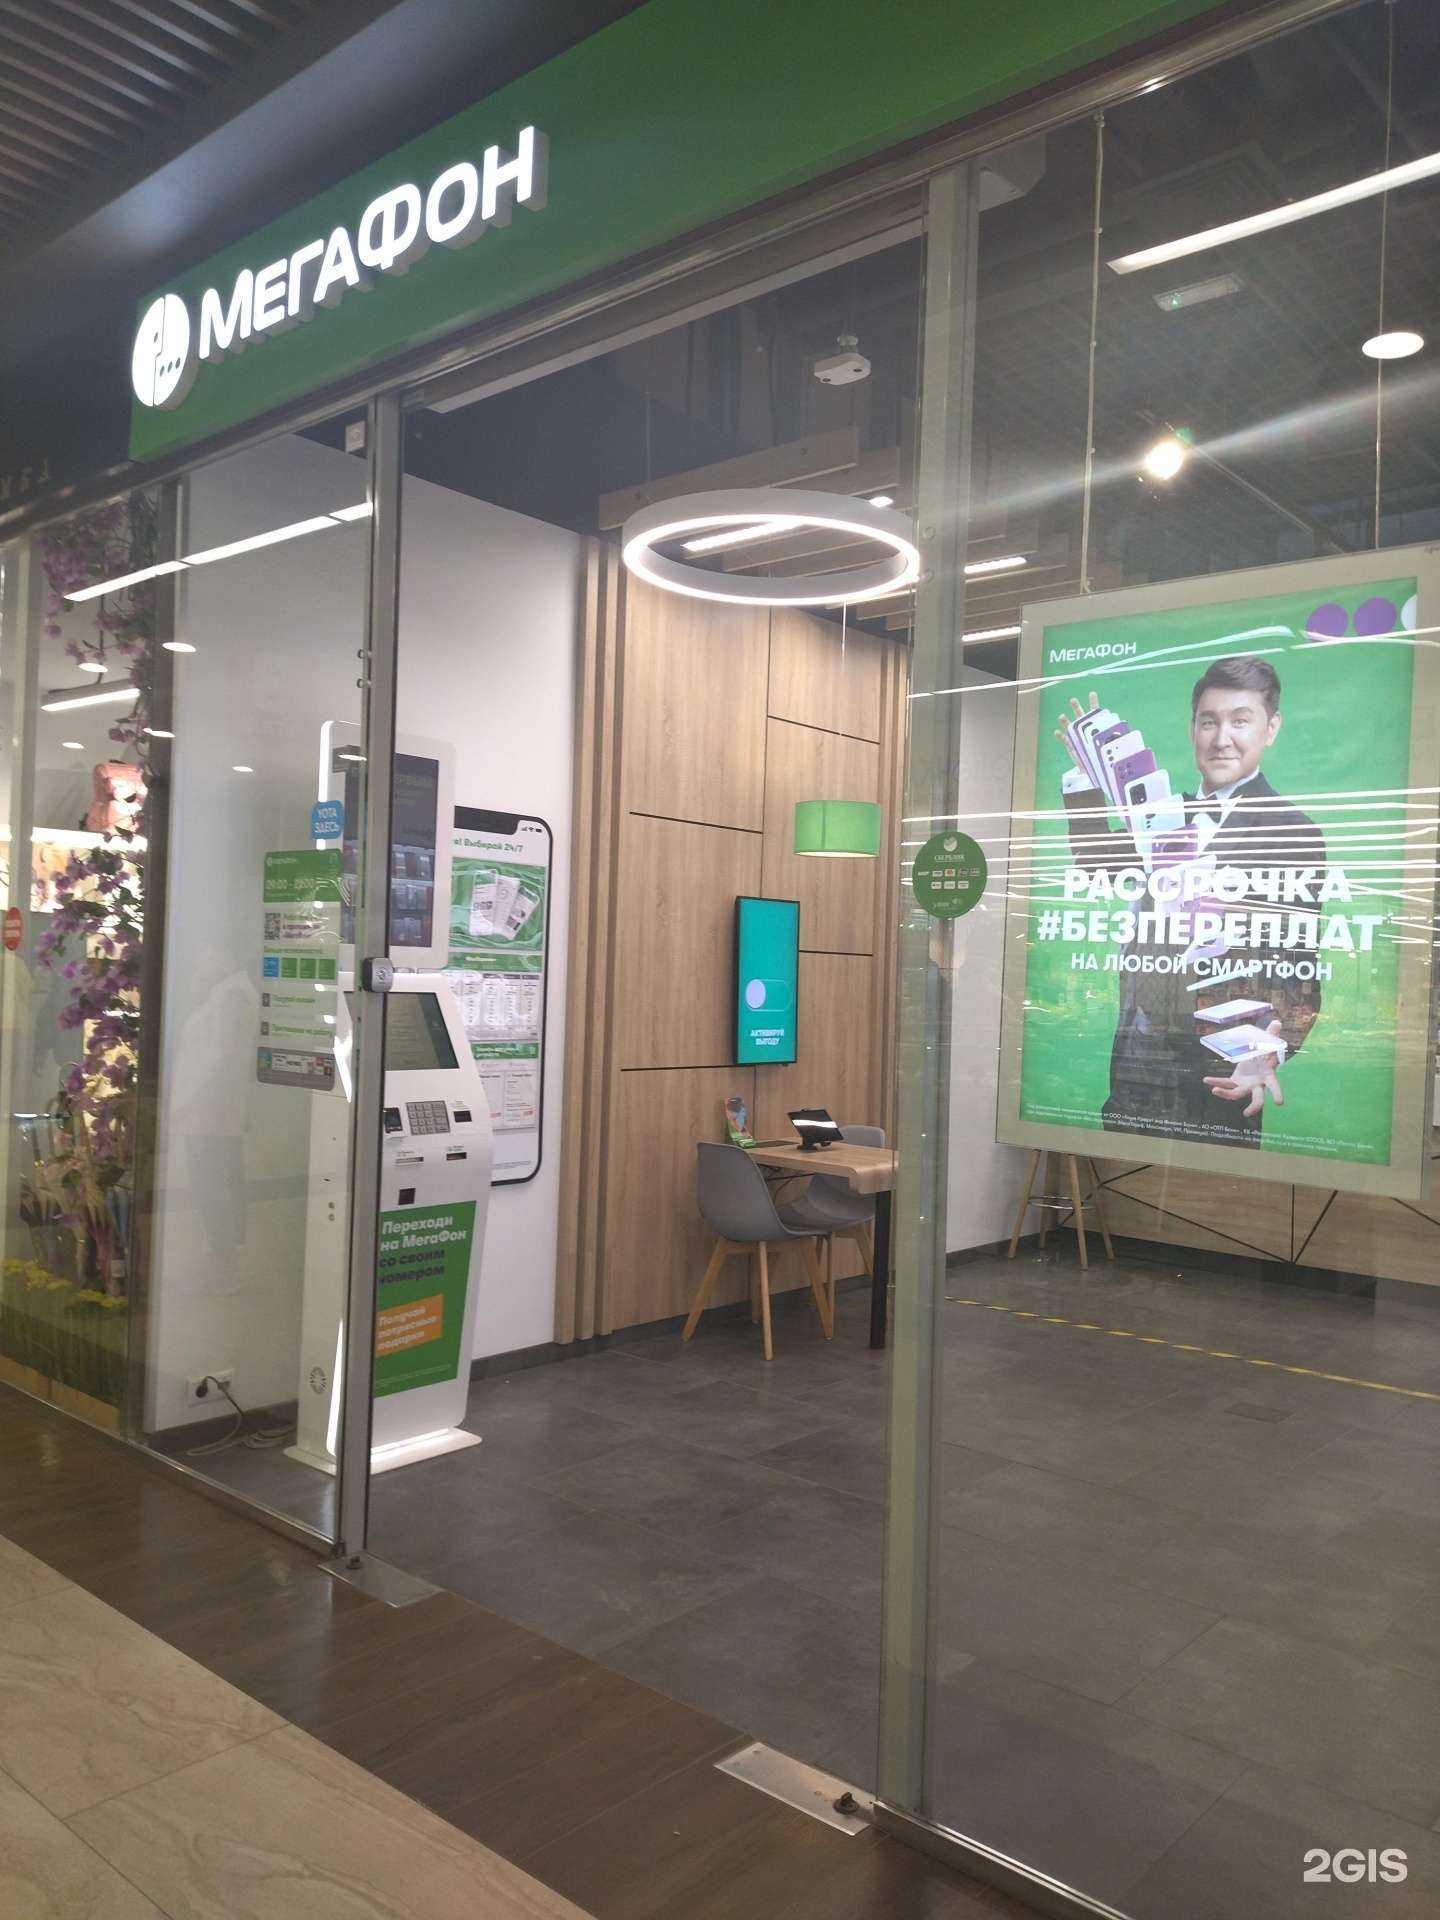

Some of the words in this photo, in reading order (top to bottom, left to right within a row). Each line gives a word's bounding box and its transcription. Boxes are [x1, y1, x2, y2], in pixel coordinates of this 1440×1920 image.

[200, 125, 535, 359] МЕГАФОН
[1049, 641, 1137, 664] МЕГАФОН
[1064, 867, 1353, 903] РАССРОЧКА
[1037, 909, 1383, 951] #БЕЗПЕРЕПЛАТ
[1071, 953, 1098, 970] НА
[1103, 952, 1188, 975] ЛЮБОЙ
[1193, 957, 1333, 981] СМАРТФОН
[382, 1216, 454, 1235] Переходи
[380, 1240, 399, 1252] на
[402, 1230, 467, 1248] МегаФон
